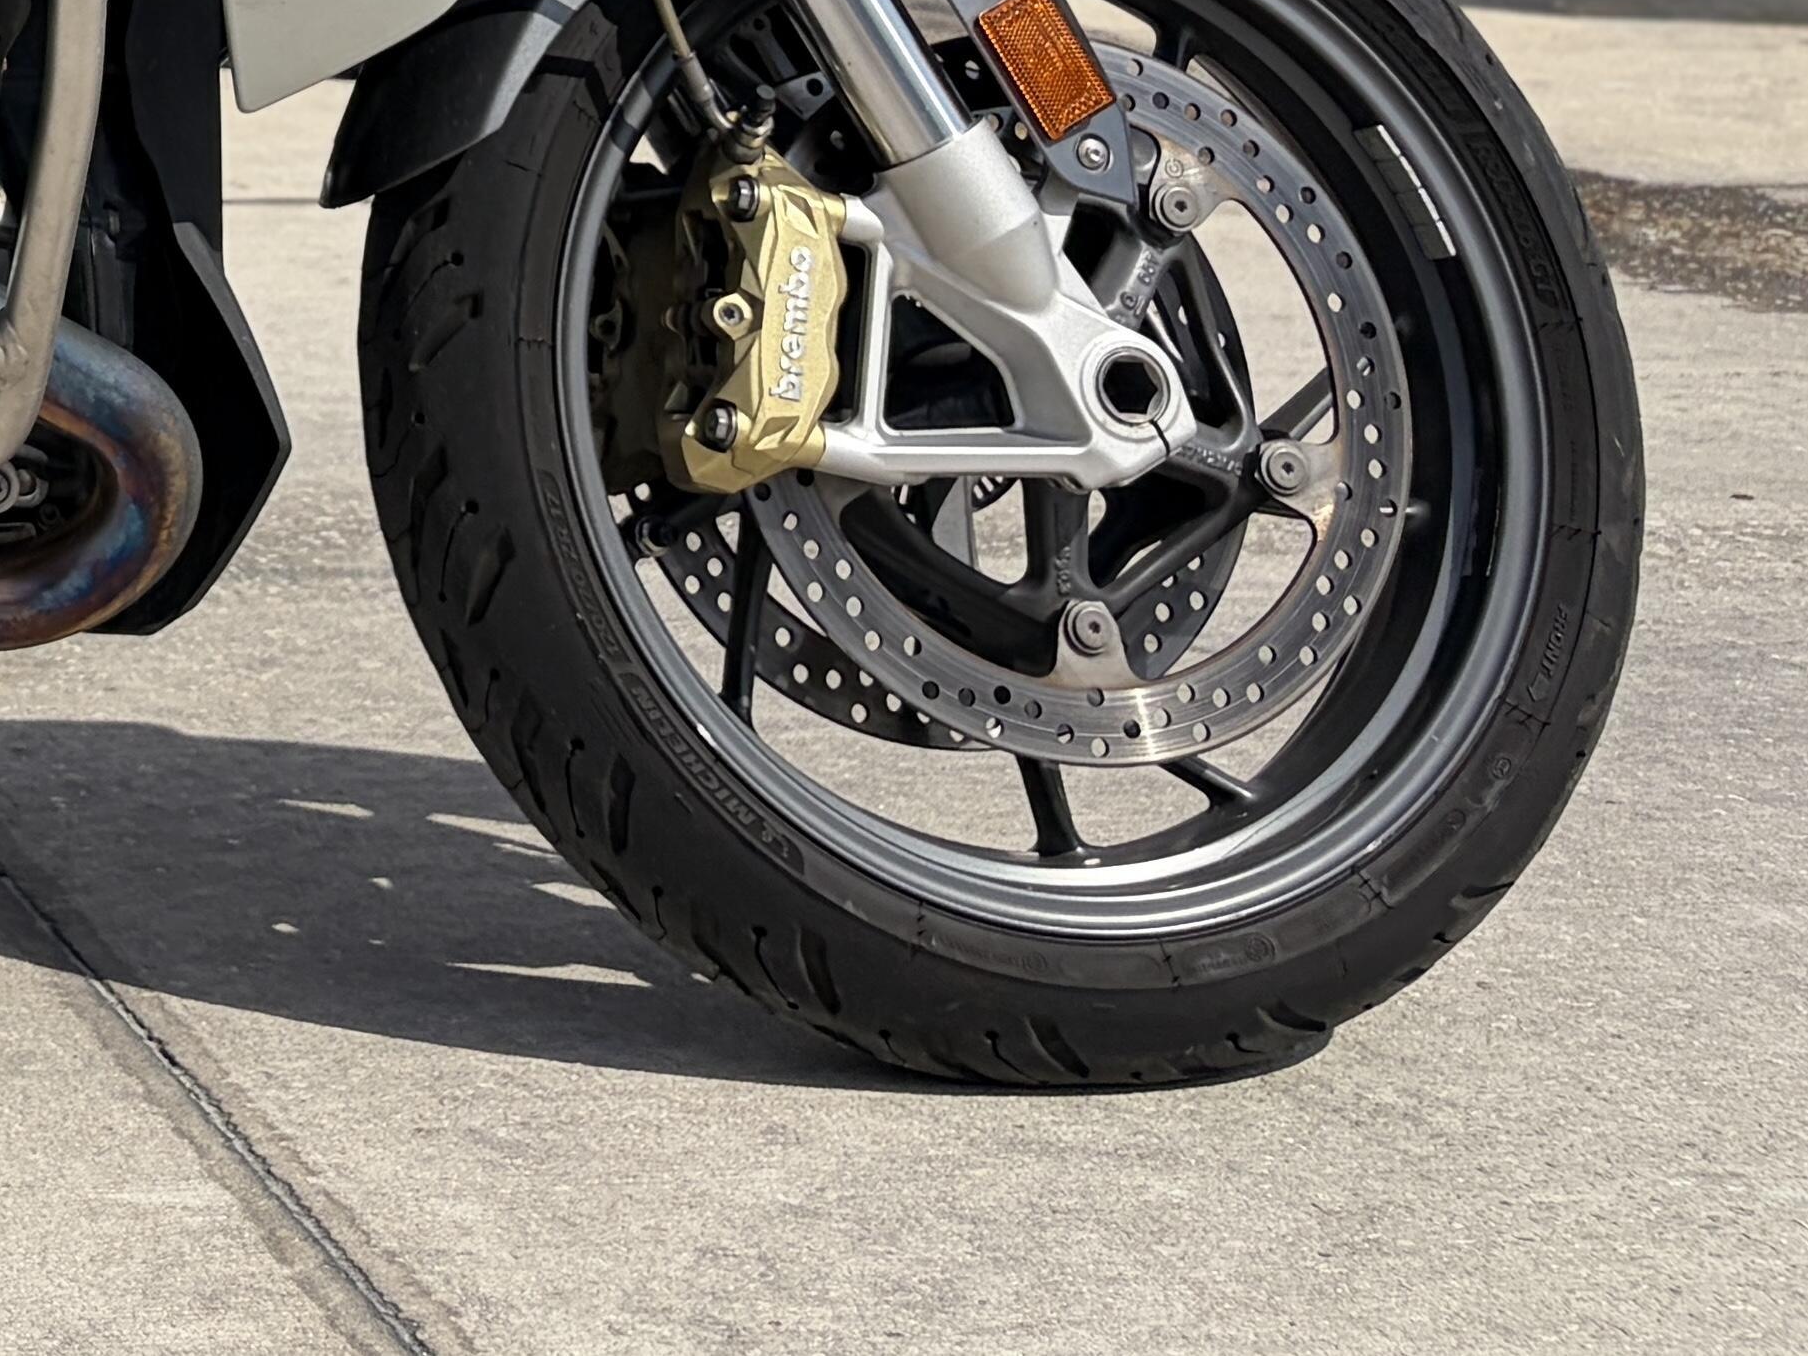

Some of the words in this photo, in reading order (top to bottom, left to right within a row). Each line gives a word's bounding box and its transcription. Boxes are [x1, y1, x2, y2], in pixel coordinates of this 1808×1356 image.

[769, 246, 812, 402] brembo
[1539, 602, 1569, 678] FRONT
[631, 684, 757, 827] MICHELIN
